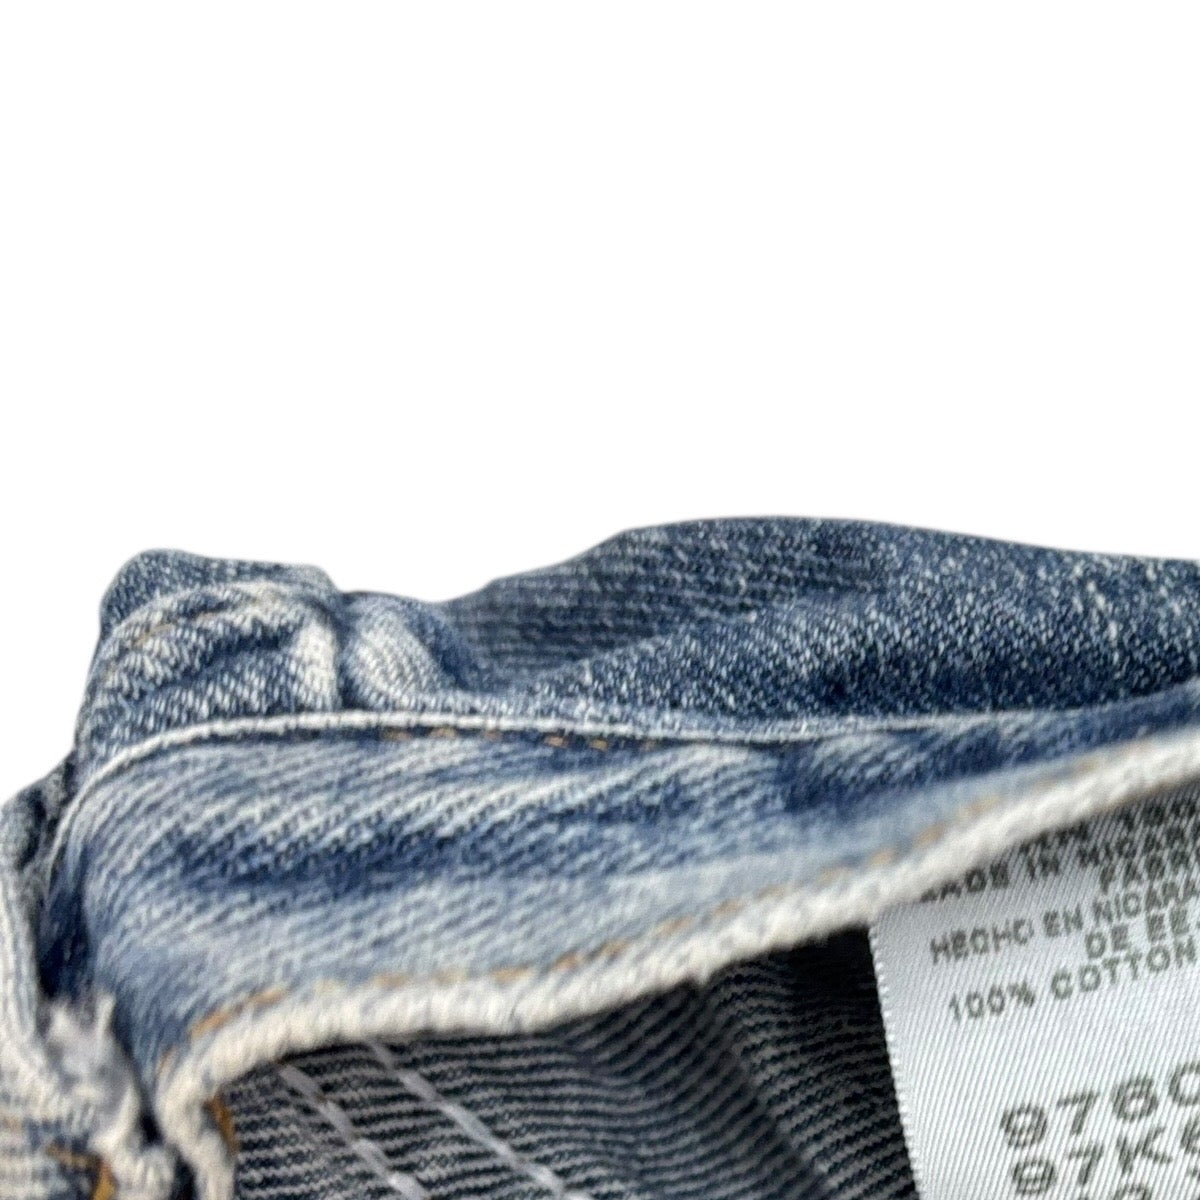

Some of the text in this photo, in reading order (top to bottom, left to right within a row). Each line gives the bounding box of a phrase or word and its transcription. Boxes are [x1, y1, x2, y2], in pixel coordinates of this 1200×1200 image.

[1027, 847, 1061, 881] IN
[930, 917, 1035, 966] HECHO
[1043, 904, 1085, 938] EN
[1085, 924, 1131, 960] DE
[950, 981, 1036, 1023] 100%
[1050, 934, 1196, 1001] COTTON
